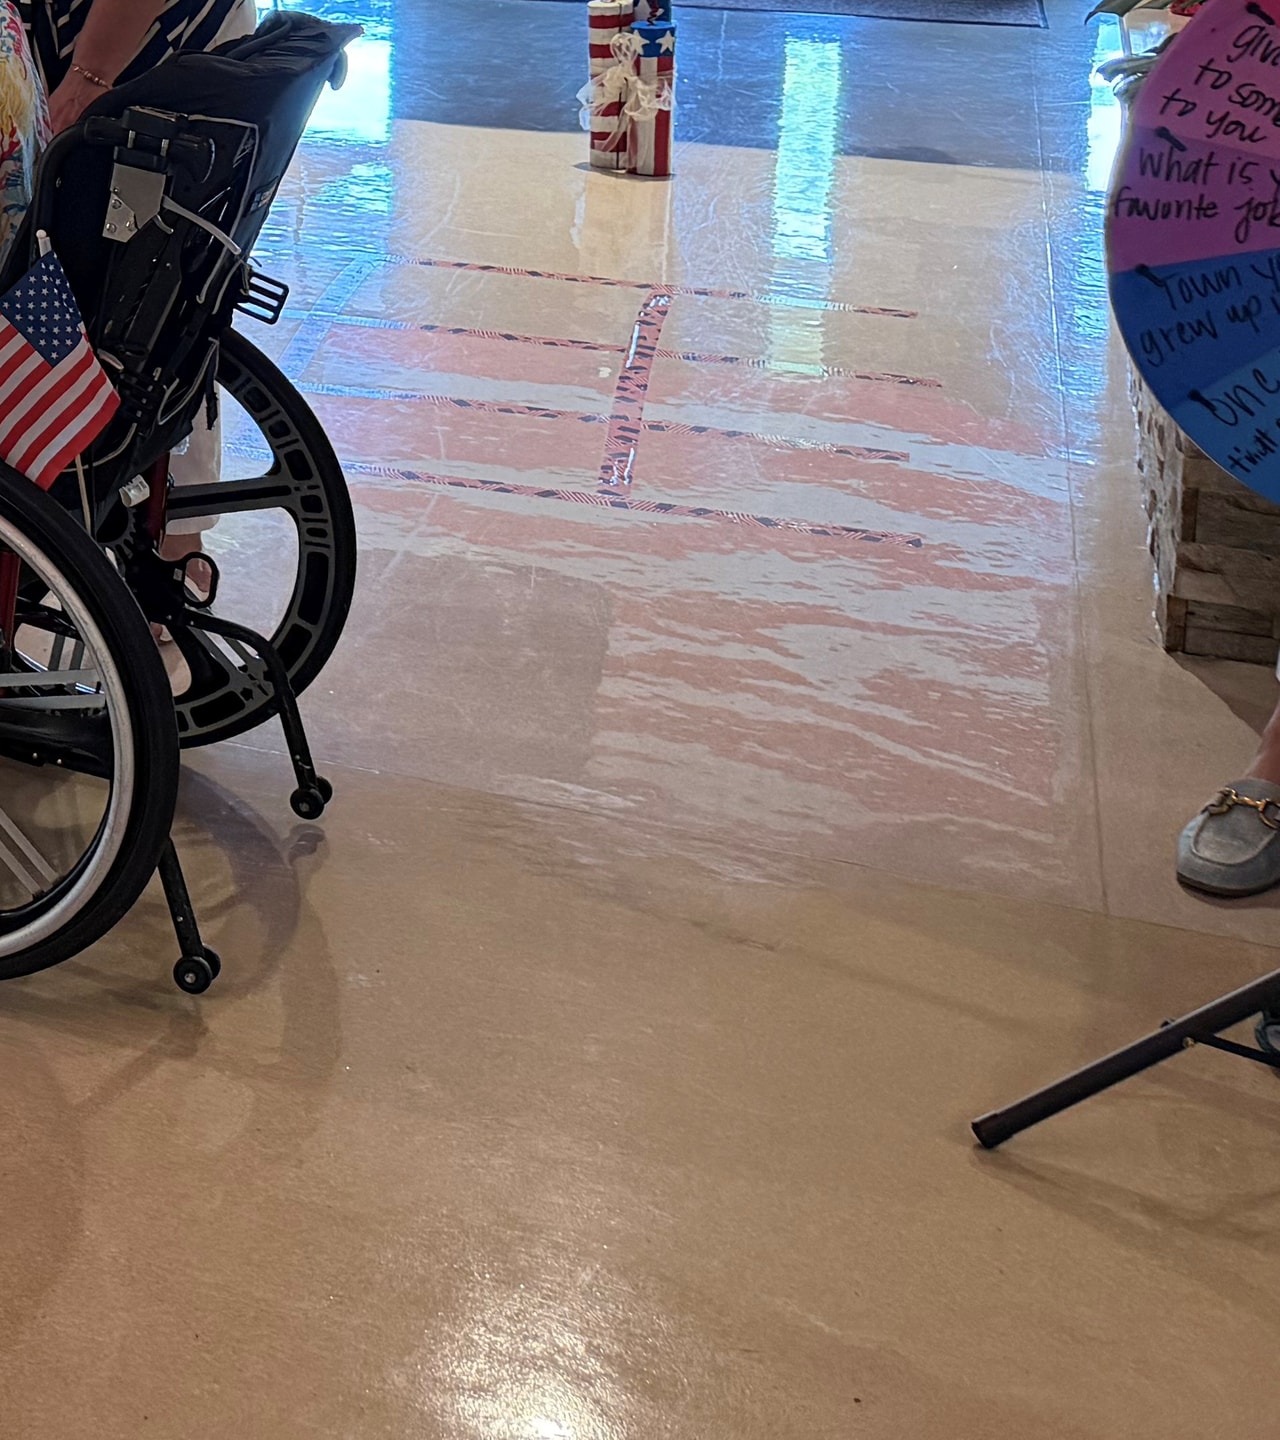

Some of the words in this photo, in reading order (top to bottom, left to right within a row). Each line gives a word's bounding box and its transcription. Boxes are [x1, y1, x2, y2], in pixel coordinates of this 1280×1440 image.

[1194, 58, 1233, 90] to
[1159, 88, 1197, 117] to
[1205, 111, 1268, 143] you
[1227, 156, 1260, 185] is
[1141, 311, 1218, 368] grew
[1225, 295, 1262, 334] up
